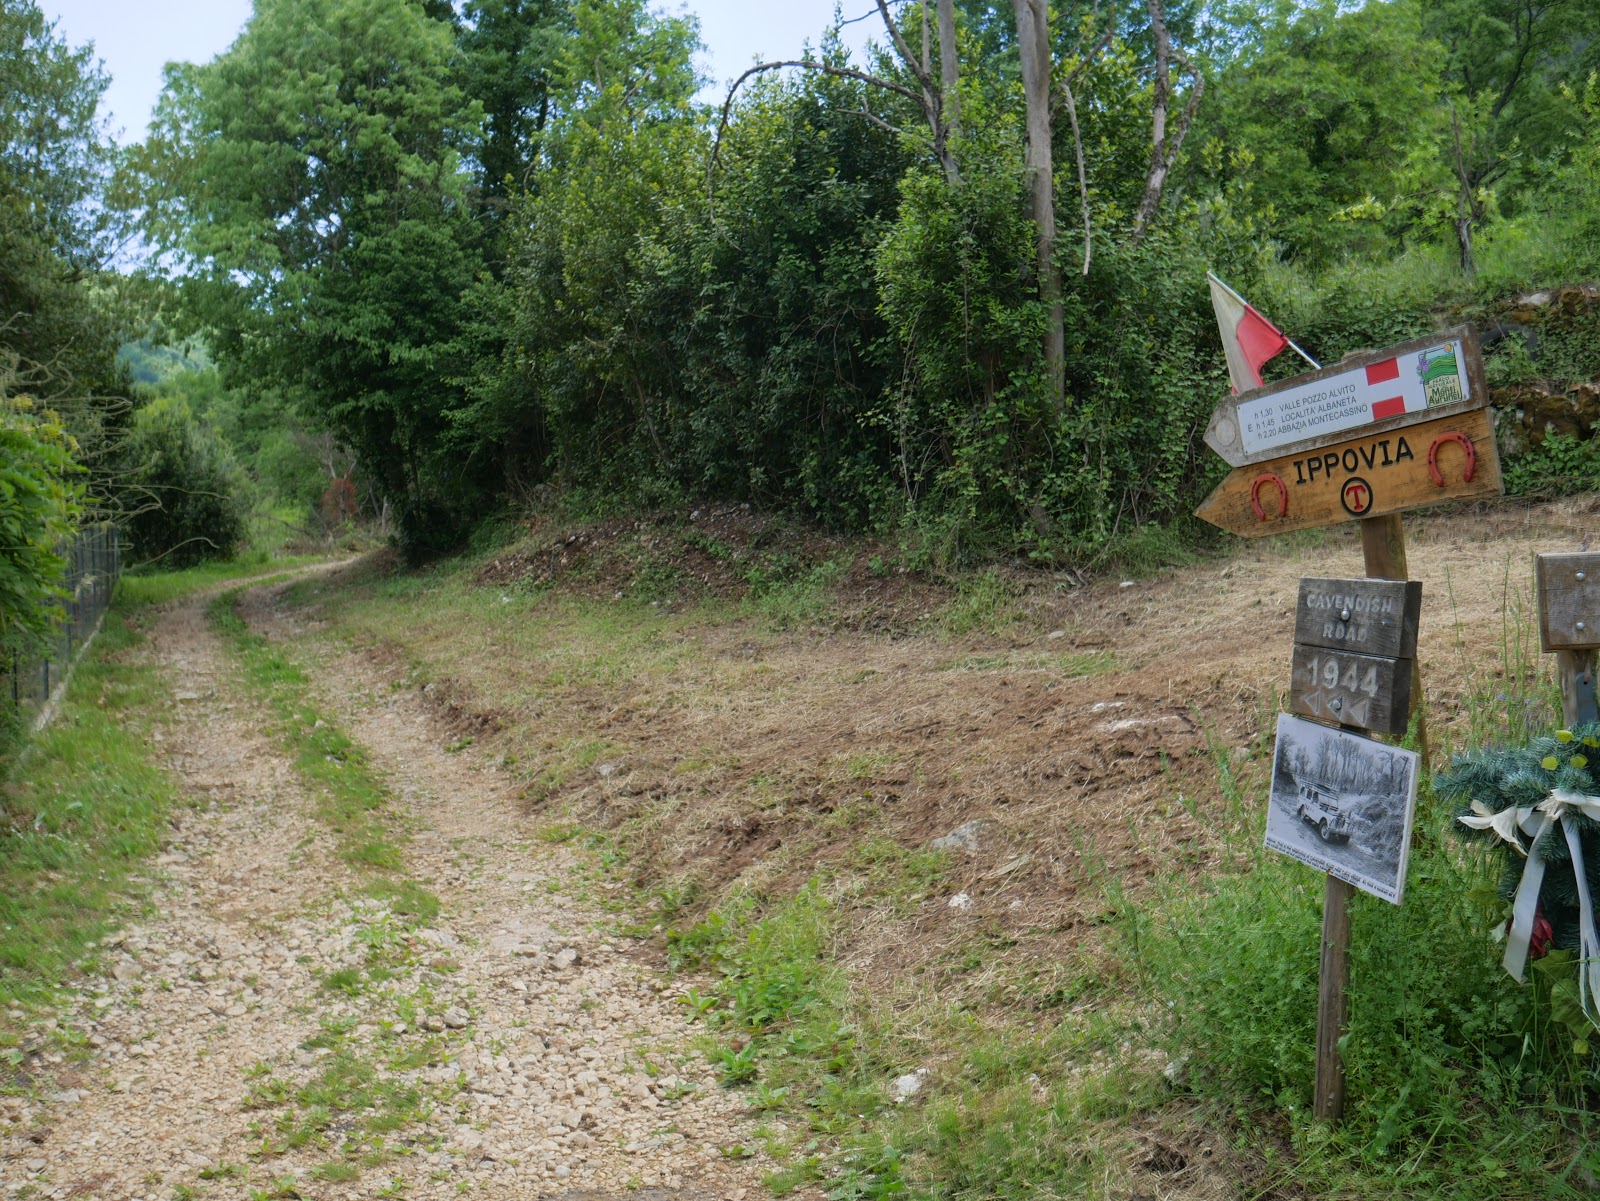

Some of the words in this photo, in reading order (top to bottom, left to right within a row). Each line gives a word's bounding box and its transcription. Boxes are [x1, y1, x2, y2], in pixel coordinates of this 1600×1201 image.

[1247, 424, 1253, 433] E
[1281, 407, 1317, 423] LOCALITA'
[1319, 395, 1357, 412] ALBANETA
[1279, 400, 1301, 412] VALLE
[1302, 393, 1328, 406] POZZO
[1329, 384, 1356, 398] ALVITO
[1258, 432, 1263, 440] h
[1278, 423, 1308, 435] ABBAZIA
[1308, 404, 1368, 427] MONTECASSINO
[1293, 436, 1414, 484] IPPOVIA
[1345, 484, 1367, 511] T
[1306, 593, 1393, 613] CAVENDISH
[1322, 621, 1367, 642] ROAD
[1306, 656, 1379, 698] 1944
